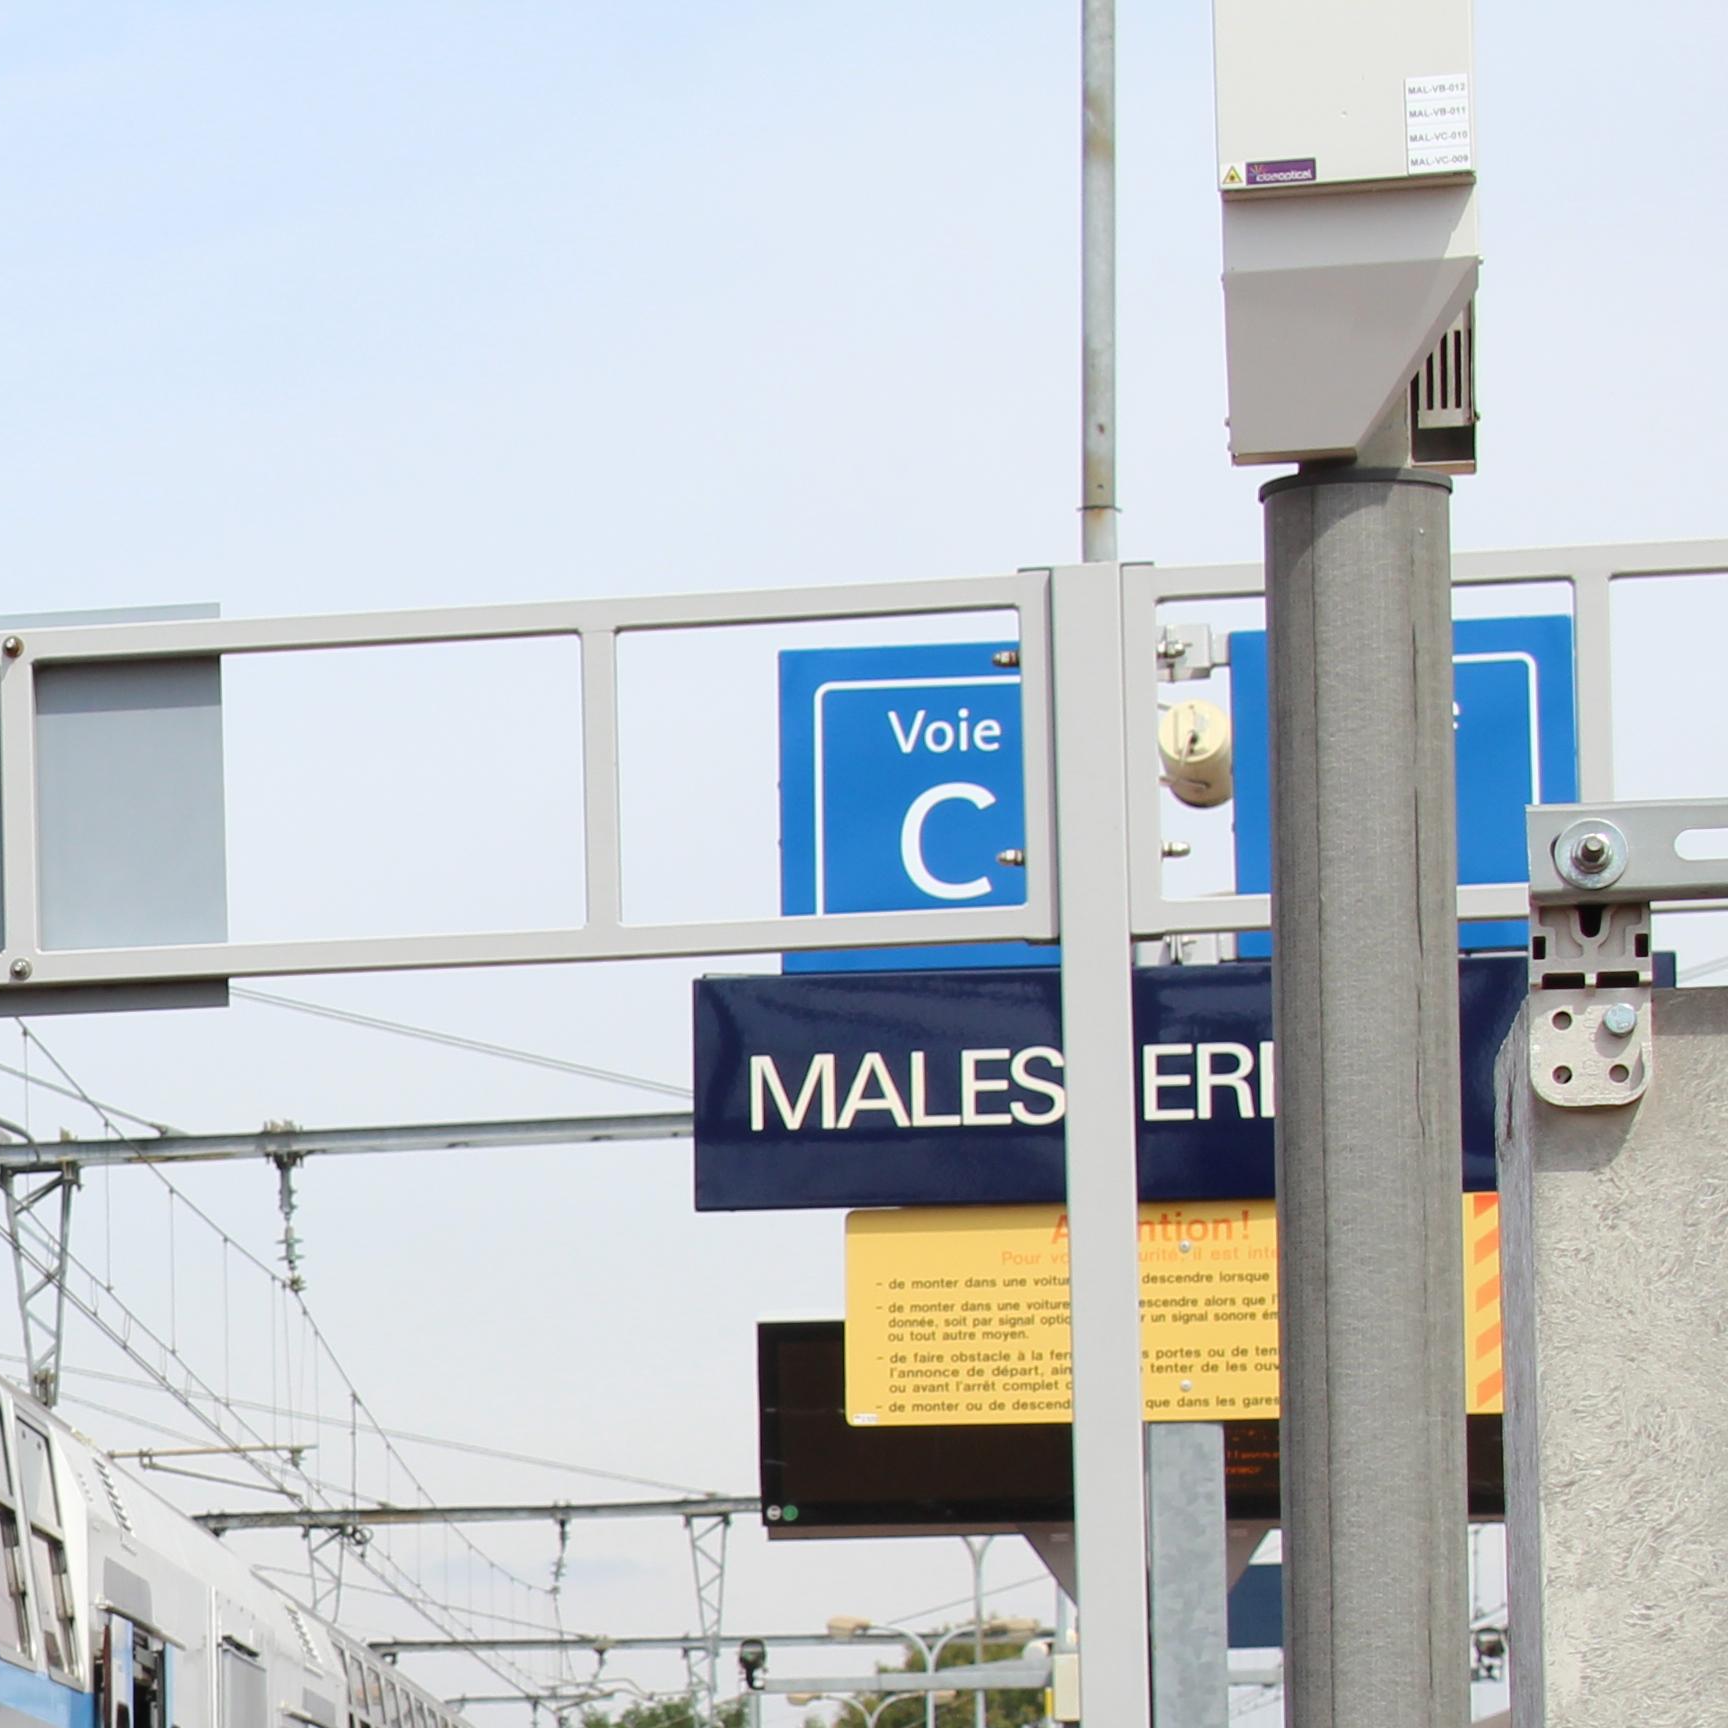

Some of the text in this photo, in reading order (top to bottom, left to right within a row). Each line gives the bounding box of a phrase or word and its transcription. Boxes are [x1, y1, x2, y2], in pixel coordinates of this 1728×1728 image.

[1409, 106, 1466, 118] MAL-VB-011
[1409, 130, 1468, 142] MAL-VC-010
[887, 707, 1002, 754] Voie
[900, 781, 997, 901] C
[749, 1043, 1277, 1132] MALESER
[1002, 1250, 1041, 1265] Pour
[888, 1278, 906, 1290] de
[911, 1277, 960, 1290] monter
[964, 1276, 997, 1289] dans
[1003, 1278, 1028, 1288] une
[1141, 1271, 1213, 1285] descendre
[1219, 1270, 1270, 1284] lorsque
[888, 1302, 904, 1314] de
[910, 1301, 956, 1313] monter
[960, 1300, 992, 1313] dans
[997, 1302, 1021, 1312] une
[1138, 1295, 1199, 1309] escendre
[1204, 1295, 1237, 1308] alors
[1242, 1296, 1266, 1308] que
[888, 1316, 939, 1329] donnée,
[944, 1315, 967, 1328] soit
[972, 1317, 993, 1329] par
[998, 1314, 1035, 1328] signal
[1151, 1313, 1166, 1323] un
[1171, 1310, 1208, 1325] signal
[1213, 1311, 1257, 1322] sonore
[888, 1329, 1029, 1343] ou tout autre moyen.
[889, 1352, 907, 1364] de
[913, 1351, 945, 1364] faire
[950, 1350, 1011, 1363] obstacle
[1017, 1349, 1026, 1362] à
[1031, 1349, 1044, 1361] la
[1155, 1347, 1202, 1361] portes
[1207, 1348, 1225, 1358] ou
[1231, 1345, 1249, 1357] de
[889, 1366, 960, 1379] l'annonce
[966, 1365, 986, 1378] de
[991, 1364, 1045, 1379] départ,
[1150, 1362, 1195, 1375] tenter
[1200, 1360, 1220, 1374] de
[1226, 1360, 1248, 1373] les
[889, 1383, 906, 1394] ou
[912, 1381, 949, 1393] avant
[1002, 1379, 1058, 1393] complet
[888, 1401, 906, 1413] de
[911, 1400, 960, 1413] monter
[965, 1401, 983, 1412] ou
[988, 1399, 1006, 1411] de
[1145, 1398, 1171, 1411] que
[1176, 1395, 1211, 1409] dans
[1215, 1394, 1237, 1407] les
